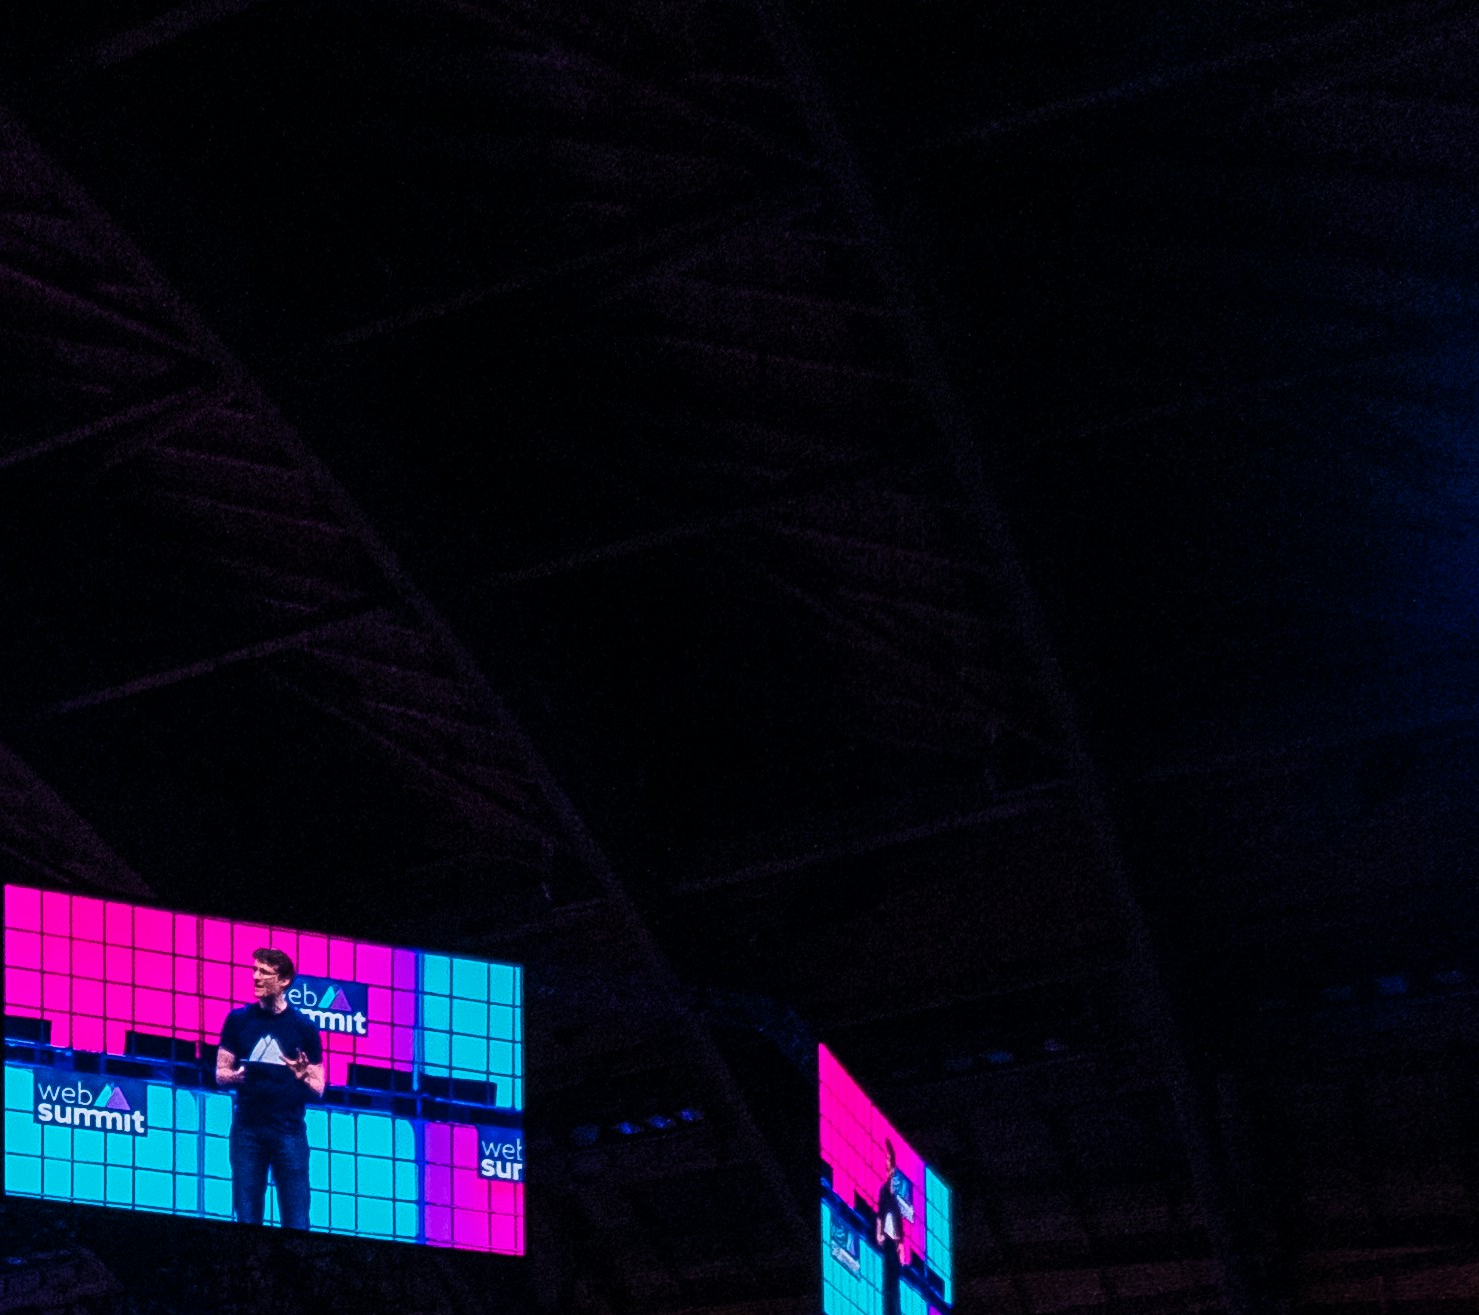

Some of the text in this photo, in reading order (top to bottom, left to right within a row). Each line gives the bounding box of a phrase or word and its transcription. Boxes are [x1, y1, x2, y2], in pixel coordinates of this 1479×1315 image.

[283, 983, 318, 1007] eb
[38, 1081, 93, 1106] web
[37, 1103, 145, 1134] summit
